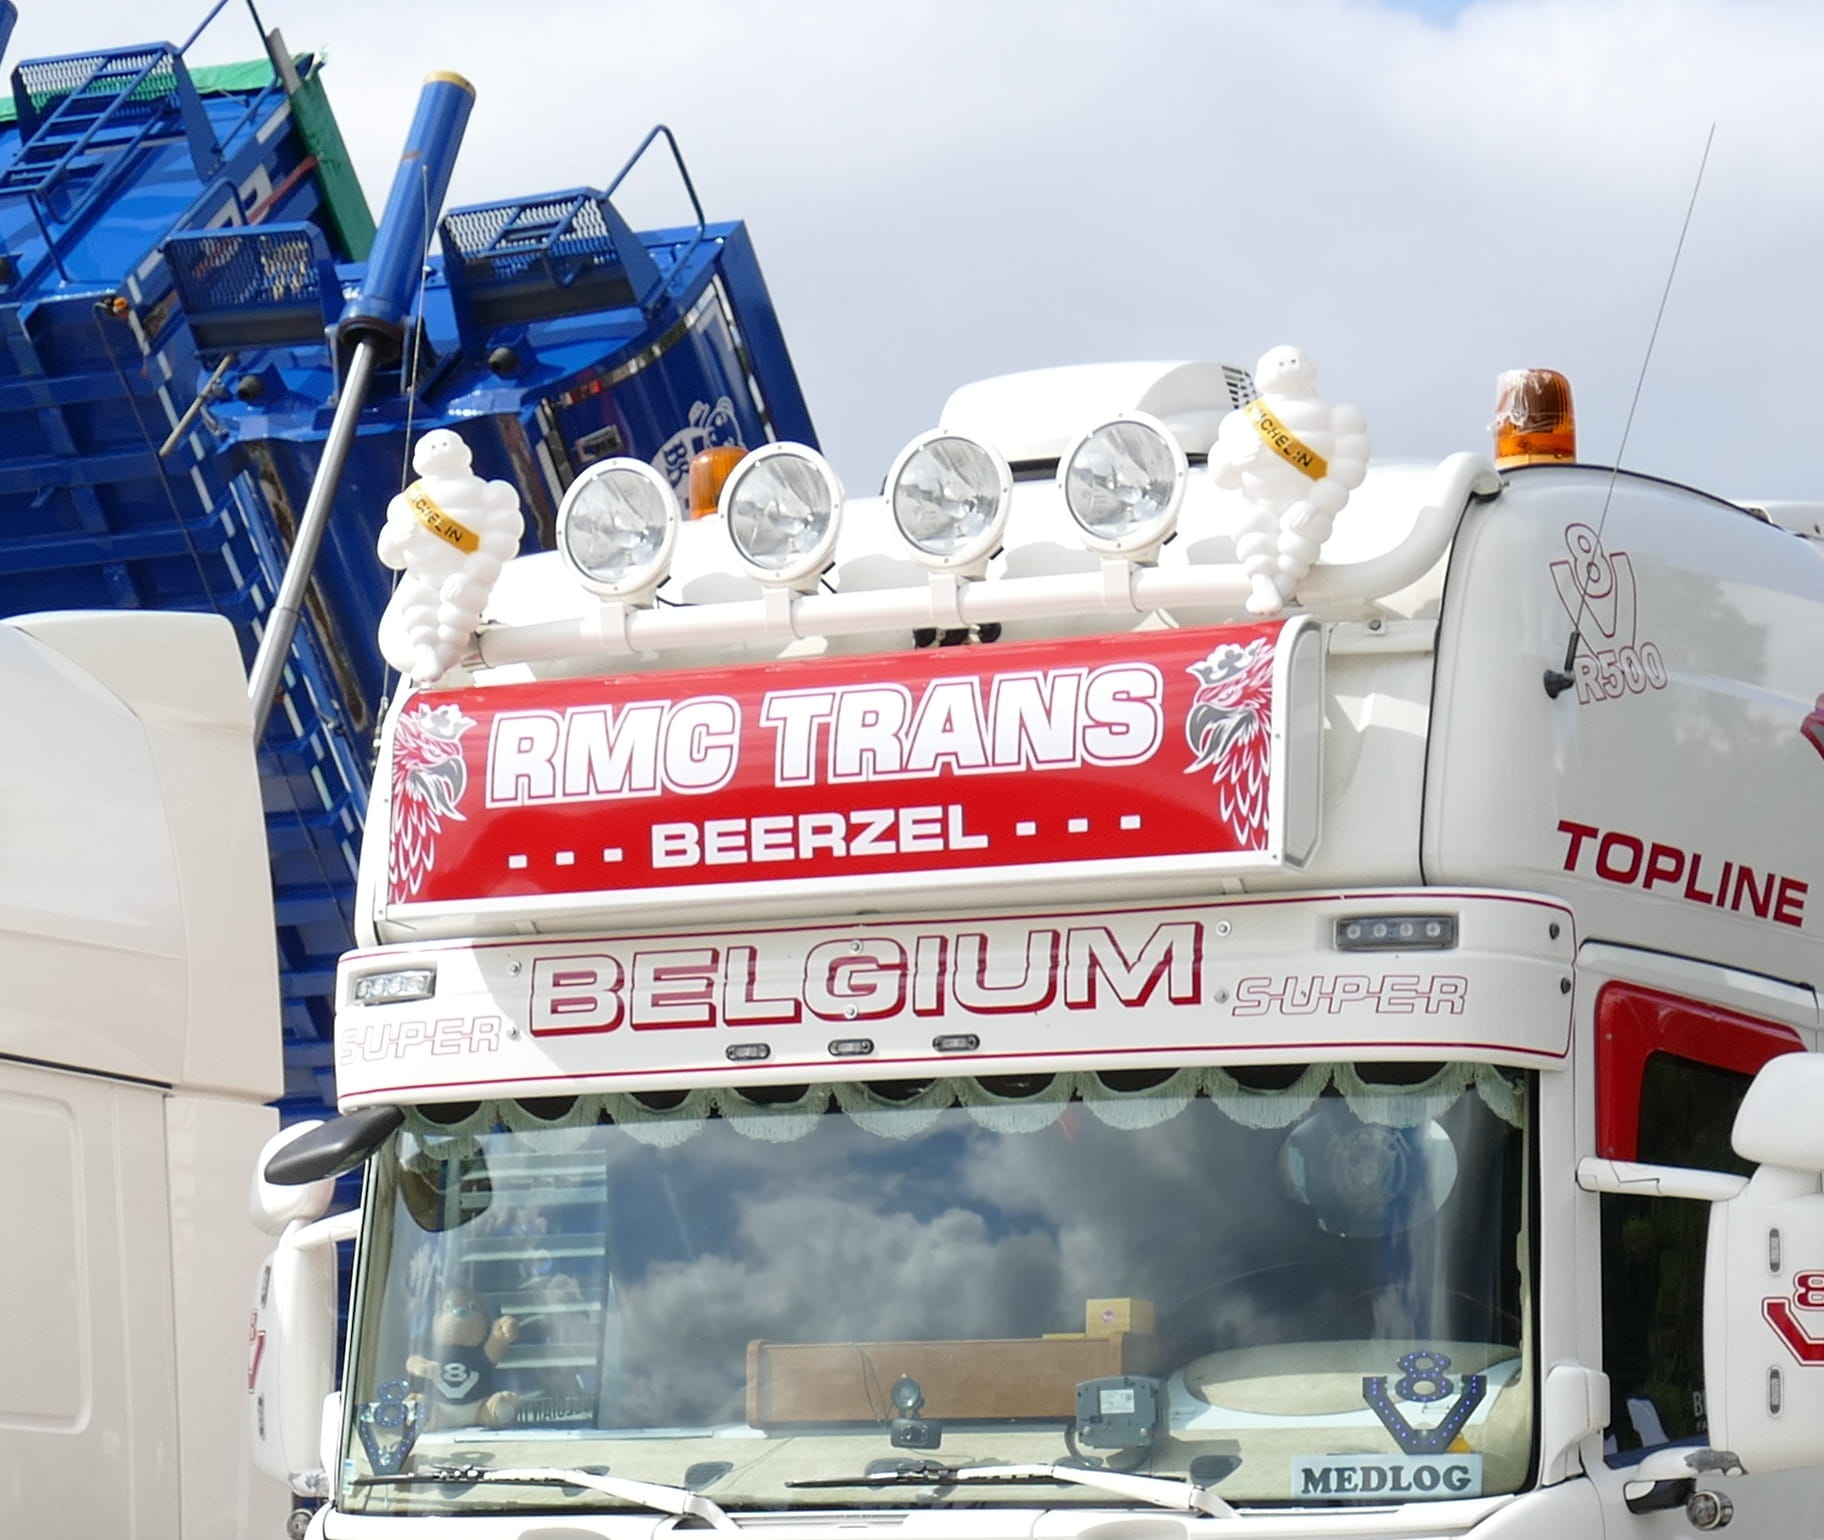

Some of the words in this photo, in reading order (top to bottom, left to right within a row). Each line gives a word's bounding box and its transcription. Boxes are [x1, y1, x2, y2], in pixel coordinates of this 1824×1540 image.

[1247, 407, 1313, 467] CHELIN
[1576, 642, 1668, 704] R500
[484, 695, 741, 809] RMC
[761, 662, 1164, 786] TRANS
[651, 803, 988, 869] BEERZEL
[1557, 819, 1808, 928] TOPLINE
[529, 919, 1205, 1038] BELGIUM
[1230, 973, 1469, 1017] SUPER
[340, 1015, 502, 1066] SUPER
[1302, 1464, 1472, 1494] MEDLOG
